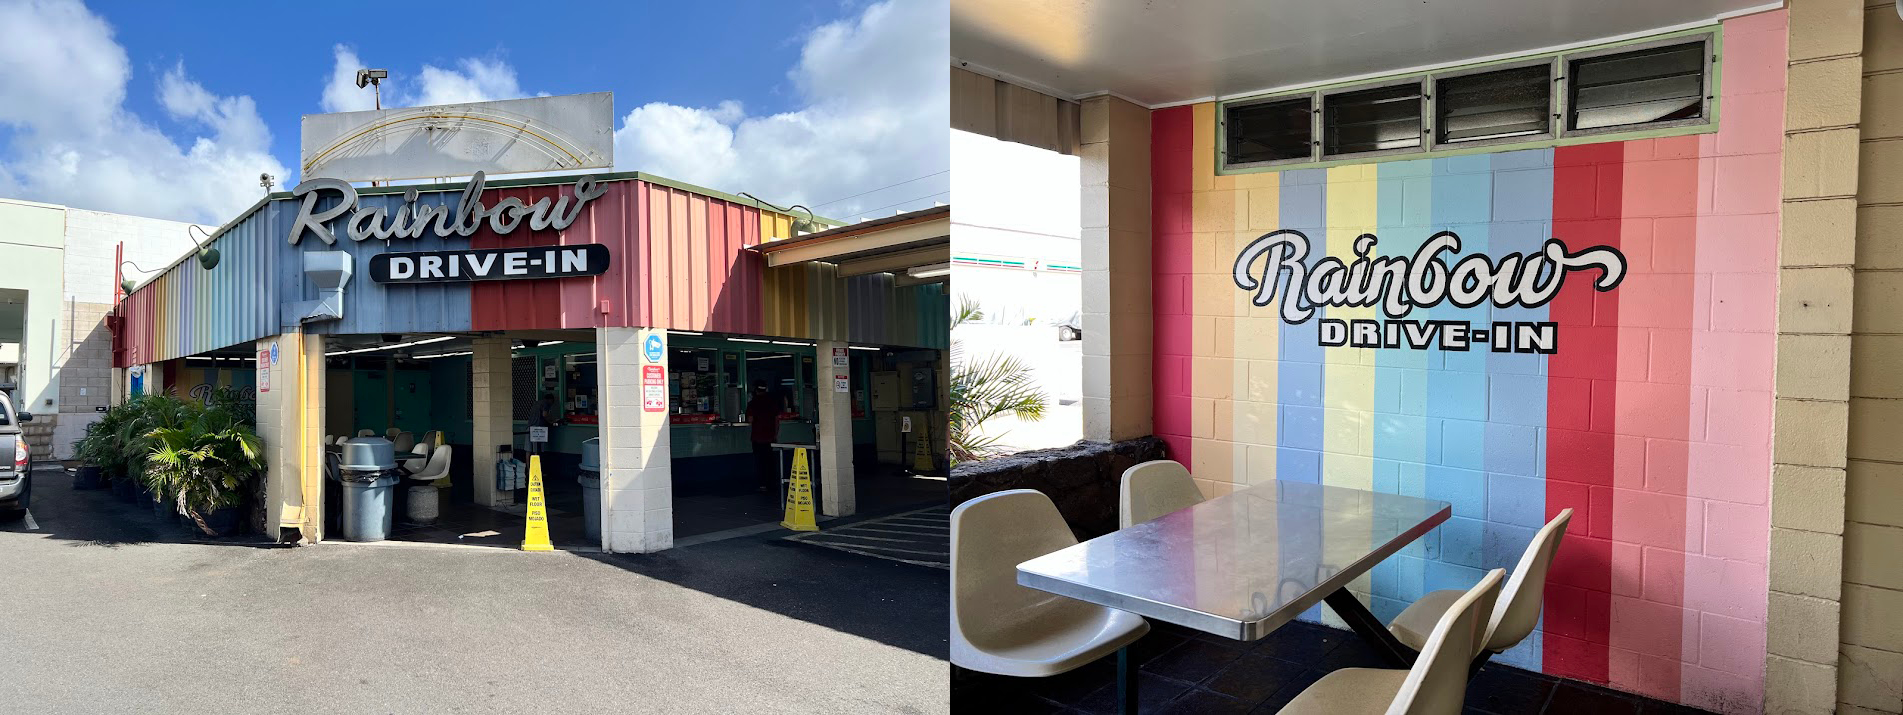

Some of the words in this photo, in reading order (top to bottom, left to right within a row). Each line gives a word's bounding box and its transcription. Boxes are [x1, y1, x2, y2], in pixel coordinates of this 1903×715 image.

[288, 170, 608, 245] Rainbow
[389, 249, 587, 280] DRIVE-IN
[1233, 229, 1627, 324] Rainbow
[1318, 319, 1558, 354] DRIVE-IN
